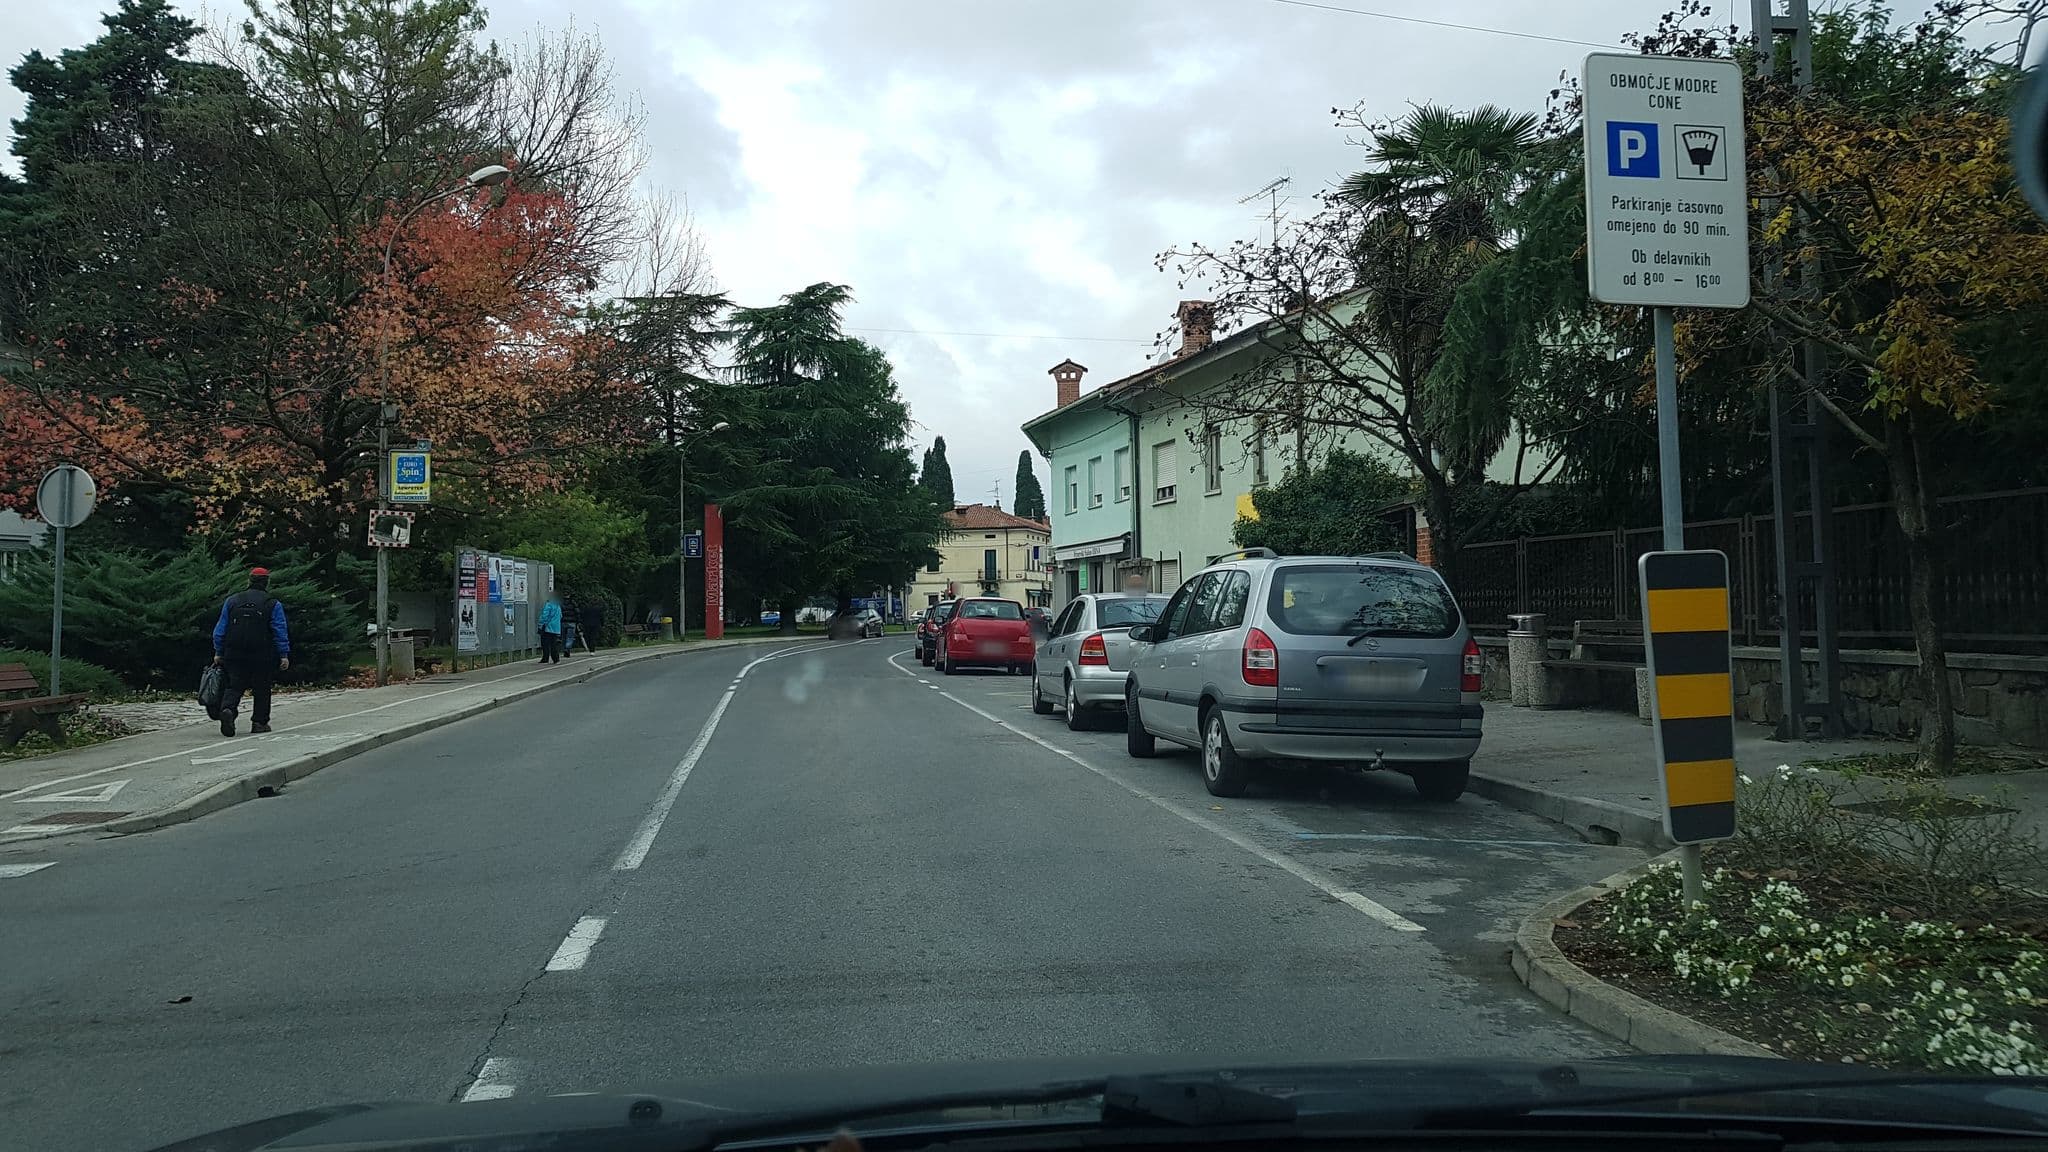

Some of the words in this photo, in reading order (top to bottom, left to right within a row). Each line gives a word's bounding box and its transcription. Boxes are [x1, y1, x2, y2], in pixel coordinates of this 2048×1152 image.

[1610, 73, 1671, 91] OBMOČJE
[1674, 78, 1718, 94] MODRE
[1648, 95, 1682, 110] CONE
[1618, 129, 1647, 169] P
[1611, 196, 1672, 216] Parkiranje
[1677, 199, 1724, 215] časovno
[1607, 219, 1656, 236] omejeno
[1663, 220, 1677, 234] do
[1683, 221, 1699, 235] 90
[1706, 222, 1730, 237] min.
[1631, 249, 1647, 264] Ob
[1654, 250, 1711, 267] delavnikih
[1623, 272, 1636, 286] od
[401, 467, 419, 477] Spin
[707, 545, 719, 606] Market
